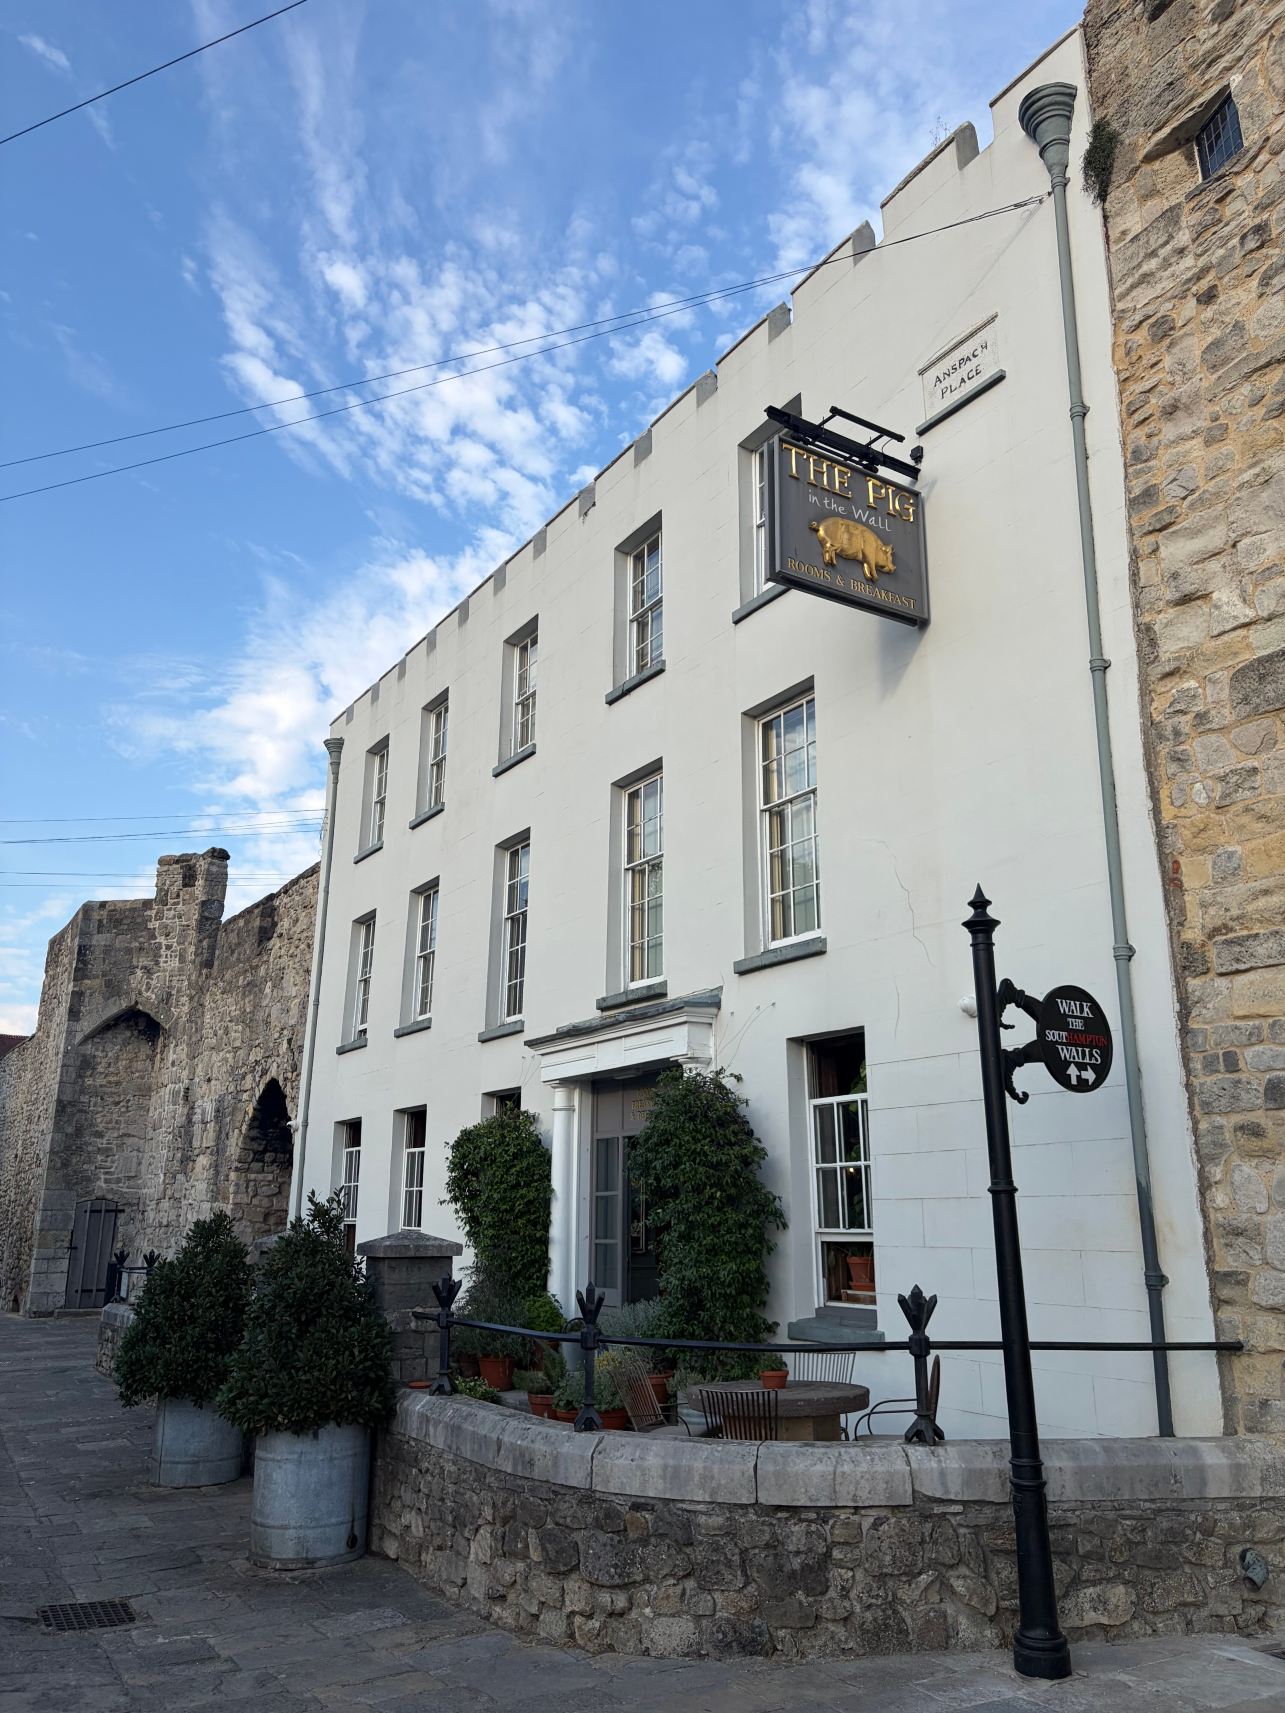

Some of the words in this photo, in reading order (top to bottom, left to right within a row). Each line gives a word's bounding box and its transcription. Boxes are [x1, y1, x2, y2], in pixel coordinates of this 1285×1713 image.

[933, 341, 988, 387] ANSPACH
[941, 364, 982, 400] PLACE
[783, 443, 852, 498] THE
[864, 476, 916, 523] PIG
[808, 489, 820, 507] in
[823, 496, 847, 514] the
[852, 505, 892, 532] Wall
[787, 557, 831, 581] ROOMS
[836, 575, 846, 587] &
[850, 579, 917, 609] BREAKFAST
[1056, 999, 1094, 1018] WALK
[1067, 1018, 1085, 1030] THE
[1045, 1029, 1108, 1047] SOUTHAMPTON
[1056, 1045, 1101, 1064] WALLS
